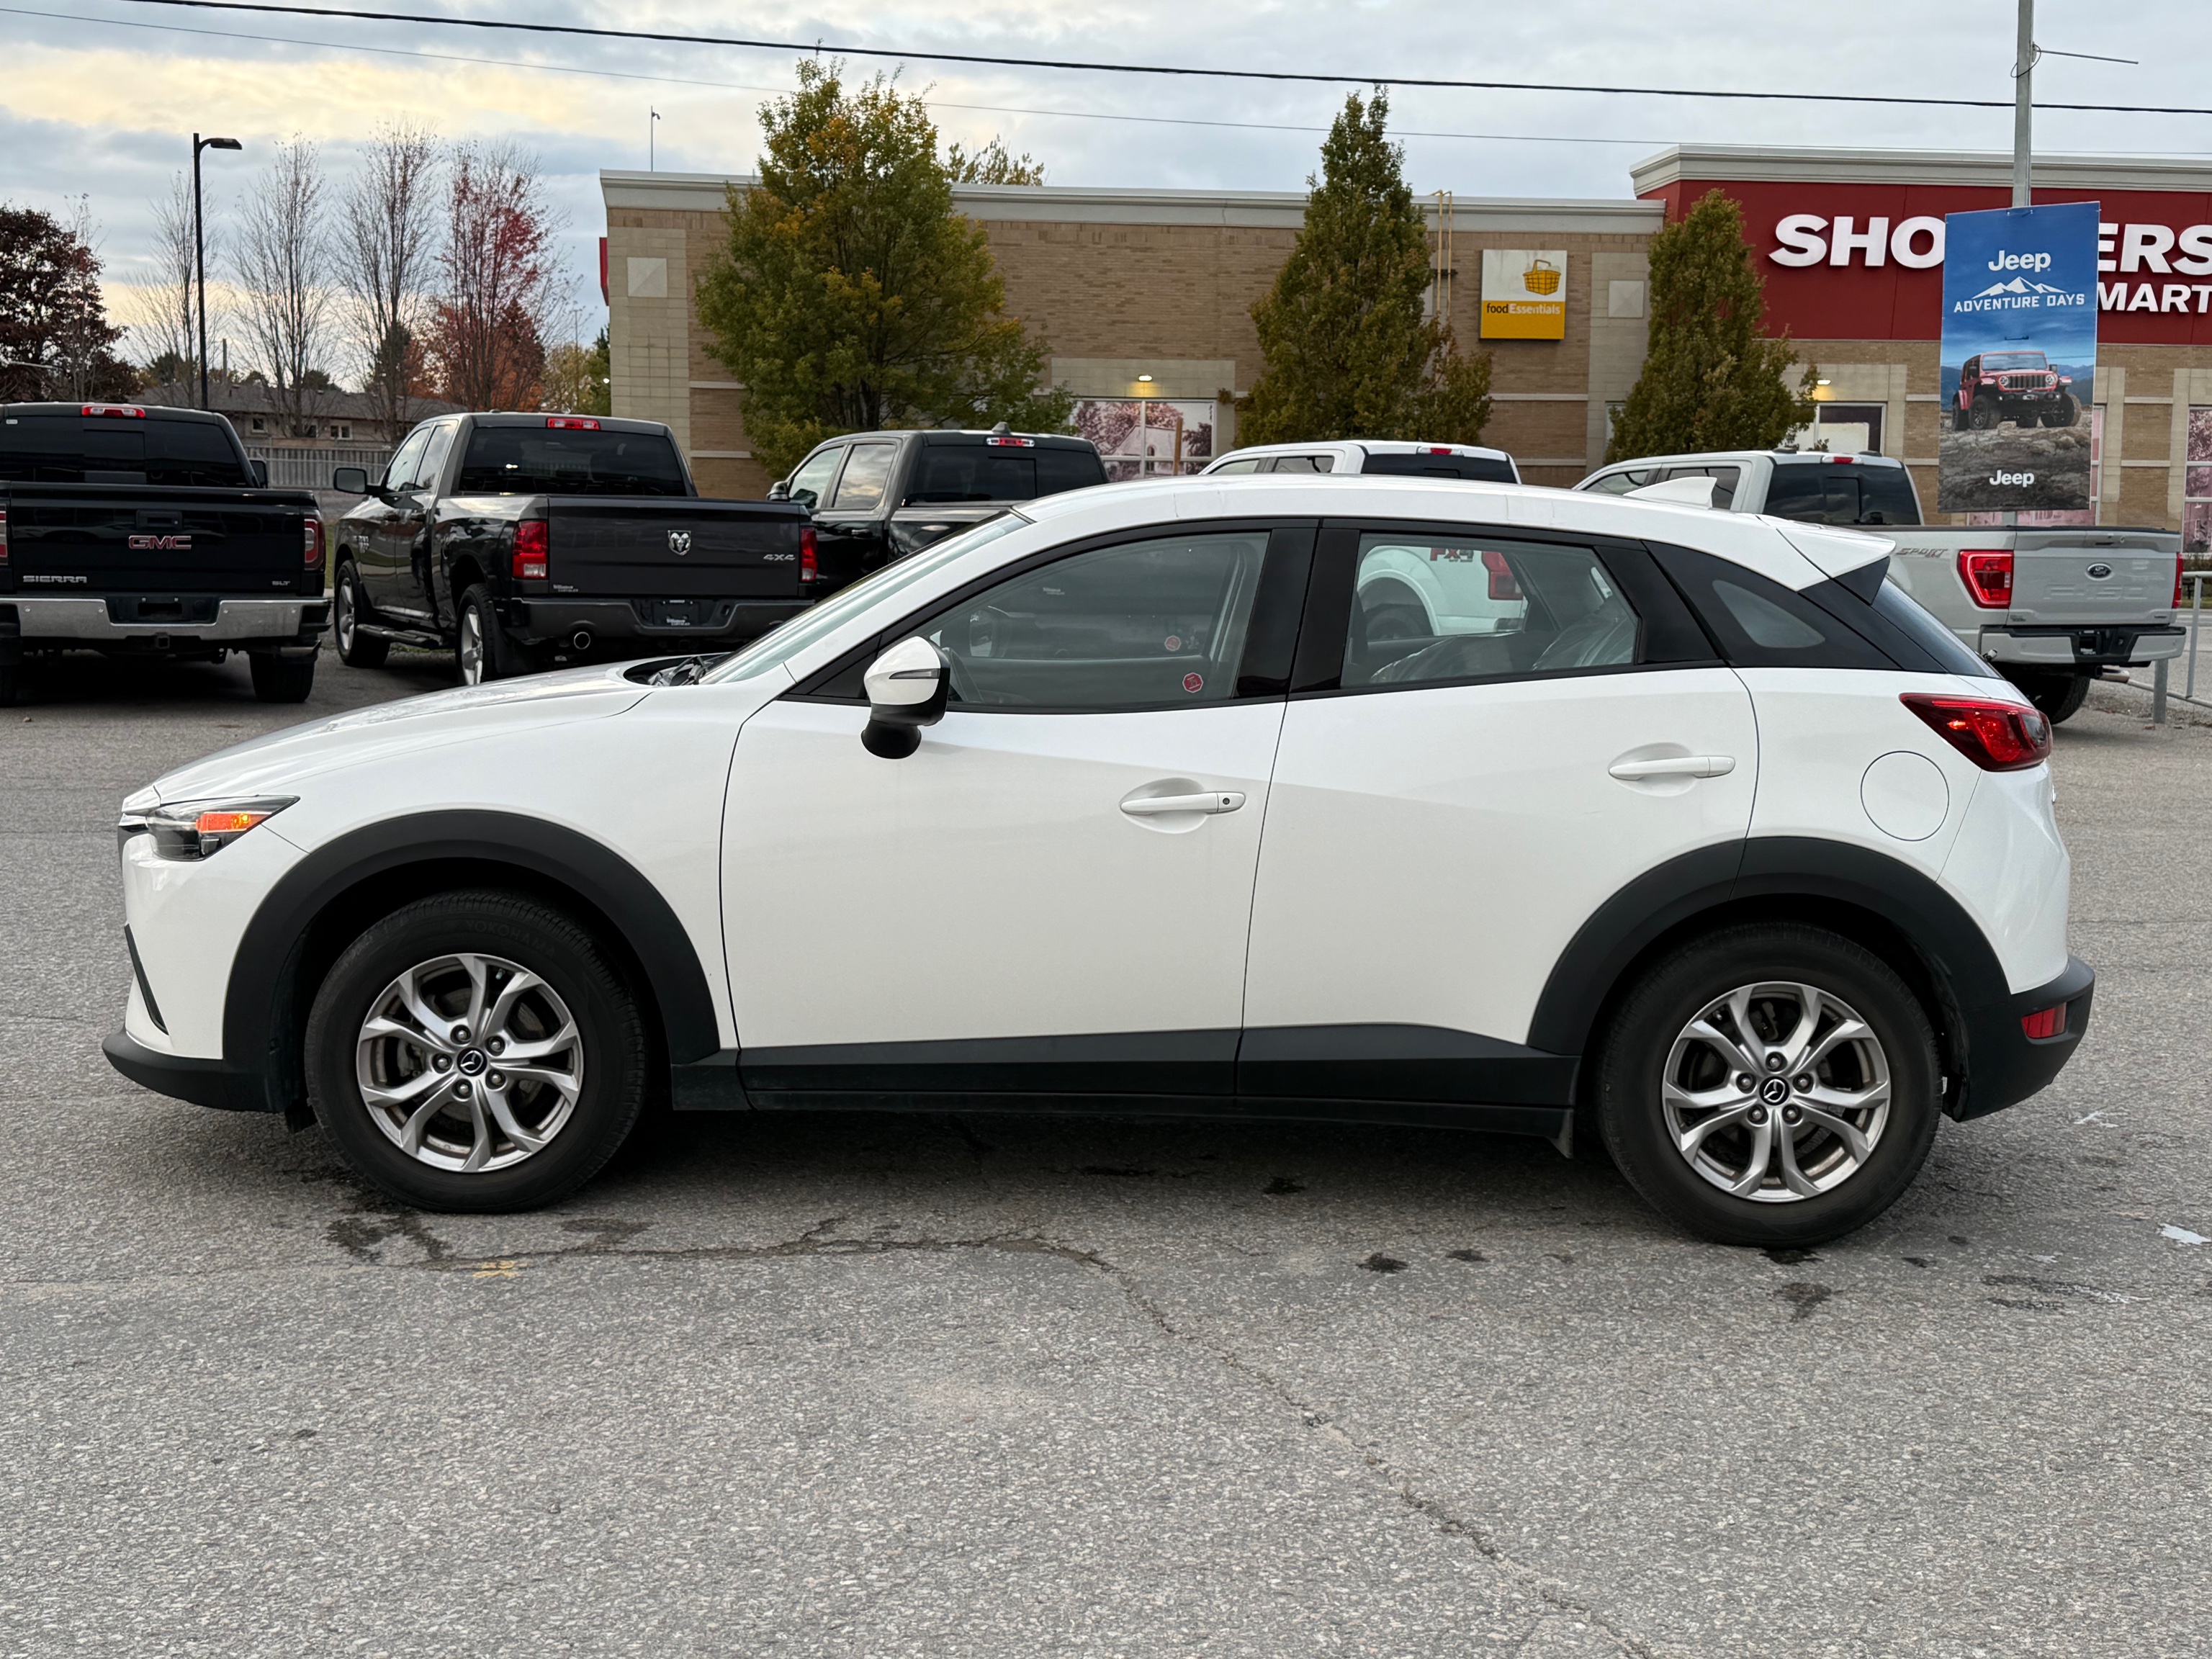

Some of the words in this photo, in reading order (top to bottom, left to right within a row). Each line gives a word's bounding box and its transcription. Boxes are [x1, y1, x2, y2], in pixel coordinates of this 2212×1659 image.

[1766, 214, 2212, 276] SHOERS
[1988, 250, 2051, 273] Jeep
[1953, 296, 2040, 313] ADVENTURE
[2046, 293, 2085, 307] DAYS
[2096, 282, 2212, 313] MART
[1989, 469, 2035, 487] Jeep
[128, 535, 192, 550] GMC
[465, 918, 557, 957] YOKOHAMA
